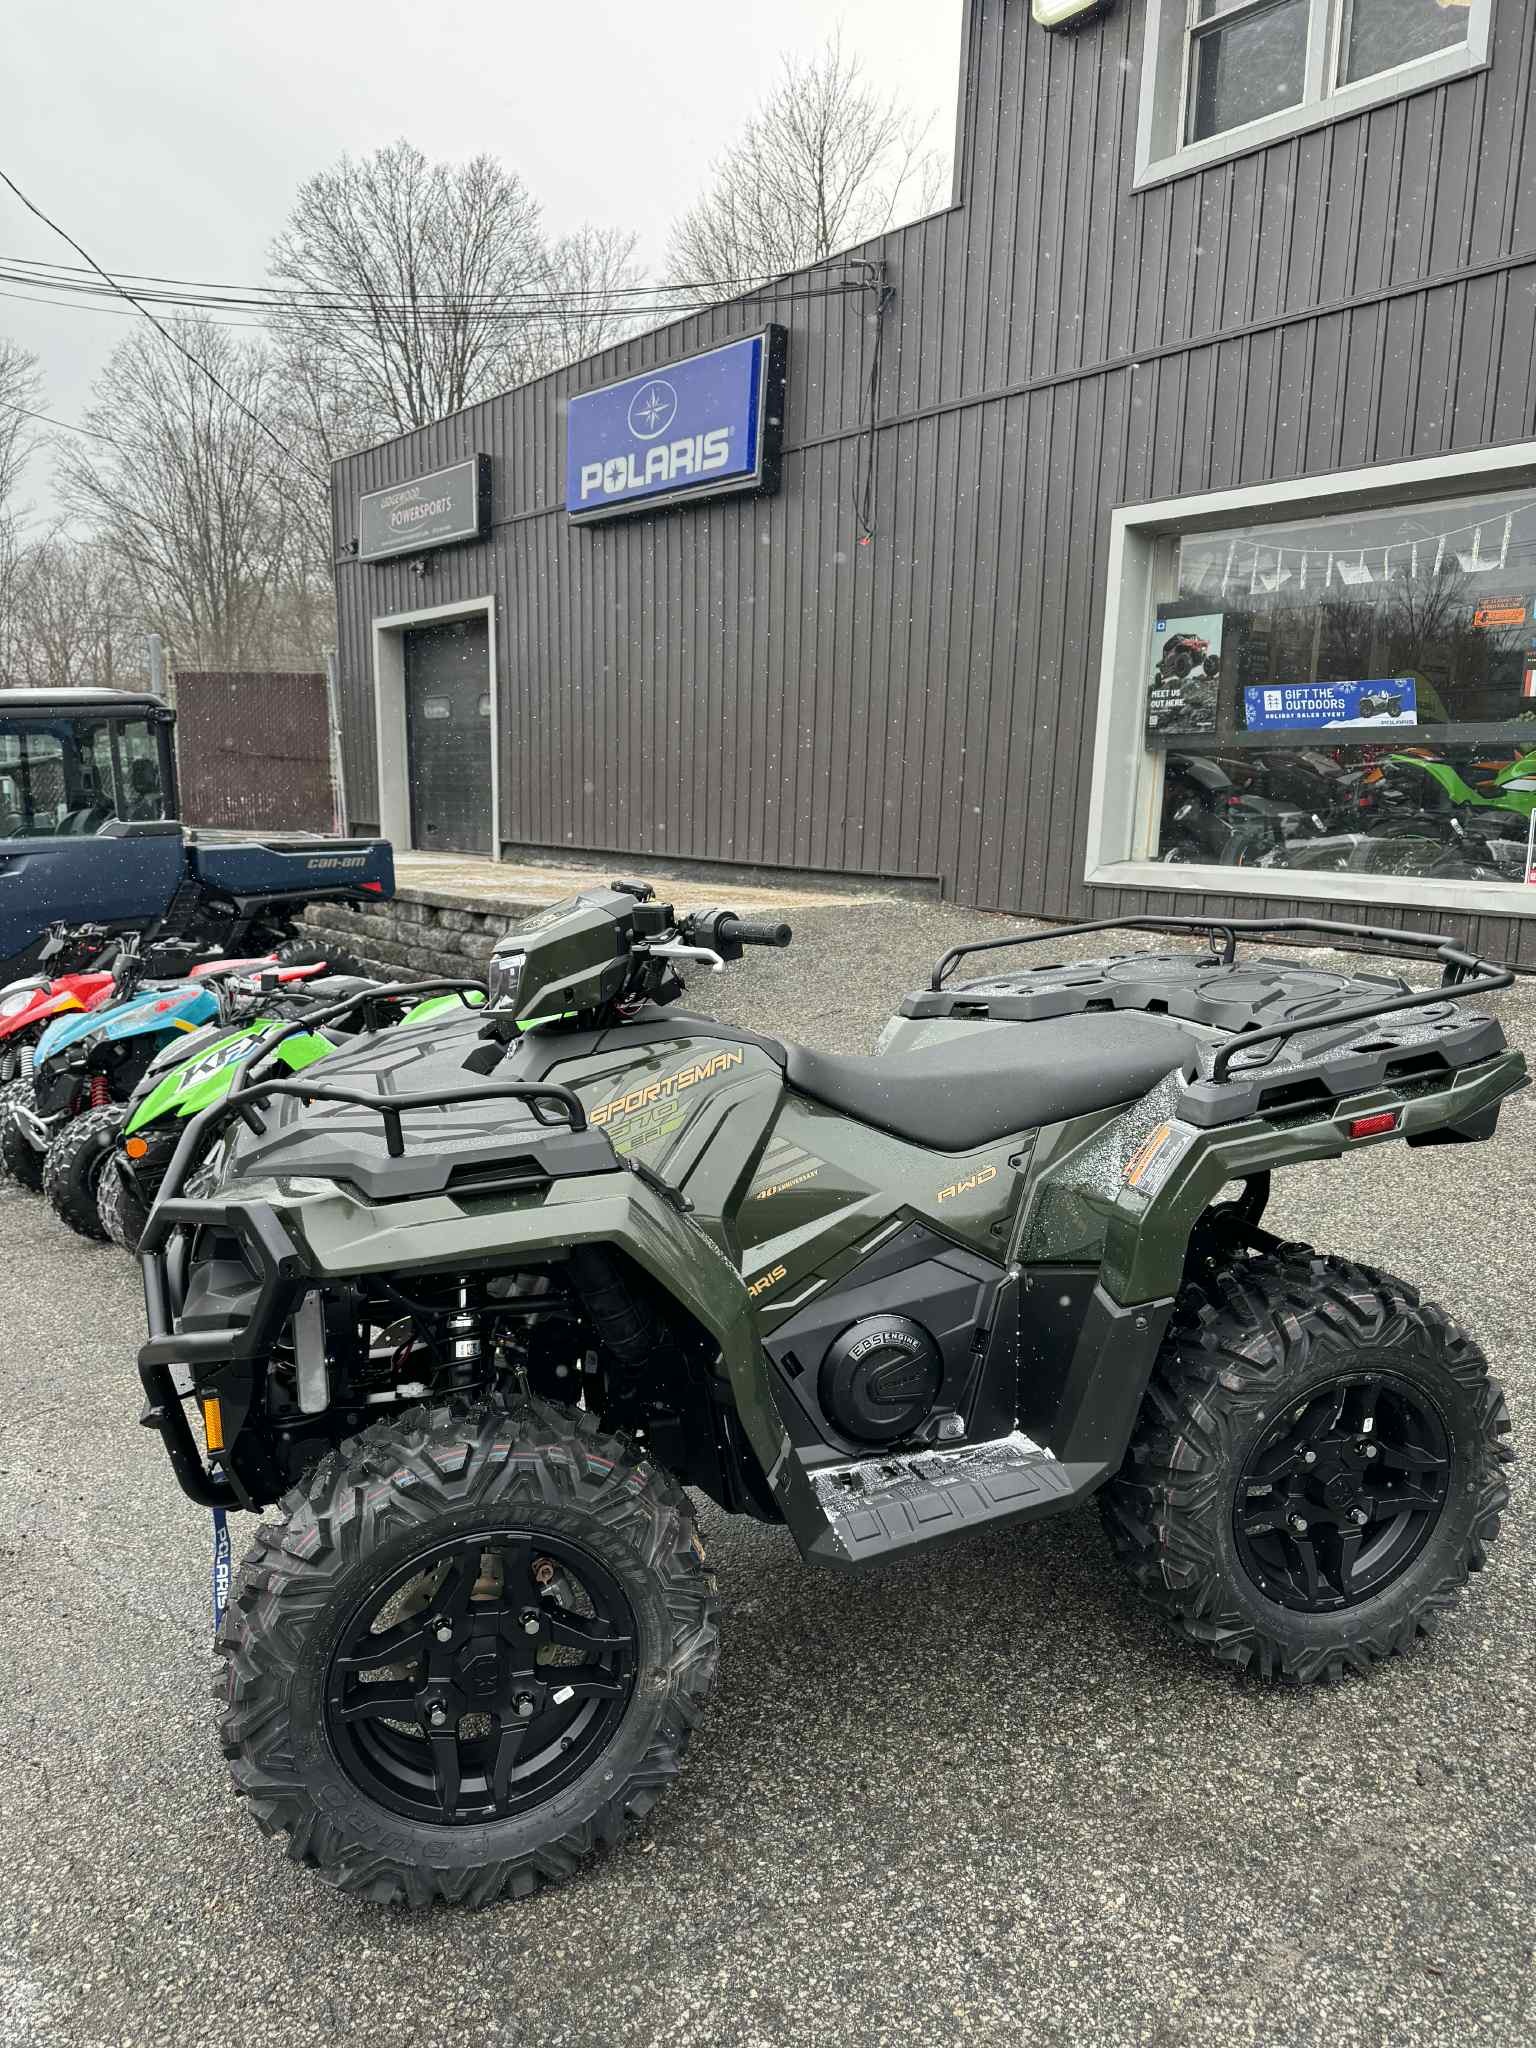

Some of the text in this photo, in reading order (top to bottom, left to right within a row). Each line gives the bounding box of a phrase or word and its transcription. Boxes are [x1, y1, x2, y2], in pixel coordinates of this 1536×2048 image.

[580, 427, 729, 500] POLARIS
[391, 497, 452, 526] POWERSPORTS
[1150, 700, 1164, 708] OUT
[1151, 689, 1181, 698] MEET US
[1285, 688, 1334, 700] GIFT THE
[1286, 699, 1346, 711] OUTDOORS
[588, 1047, 745, 1126] SPORTSMAN
[607, 1100, 679, 1137] 570
[630, 1126, 662, 1148] EFI
[937, 1166, 997, 1203] AWD
[852, 1332, 920, 1357] EBS ENGINE
[215, 1526, 229, 1609] POLARIS
